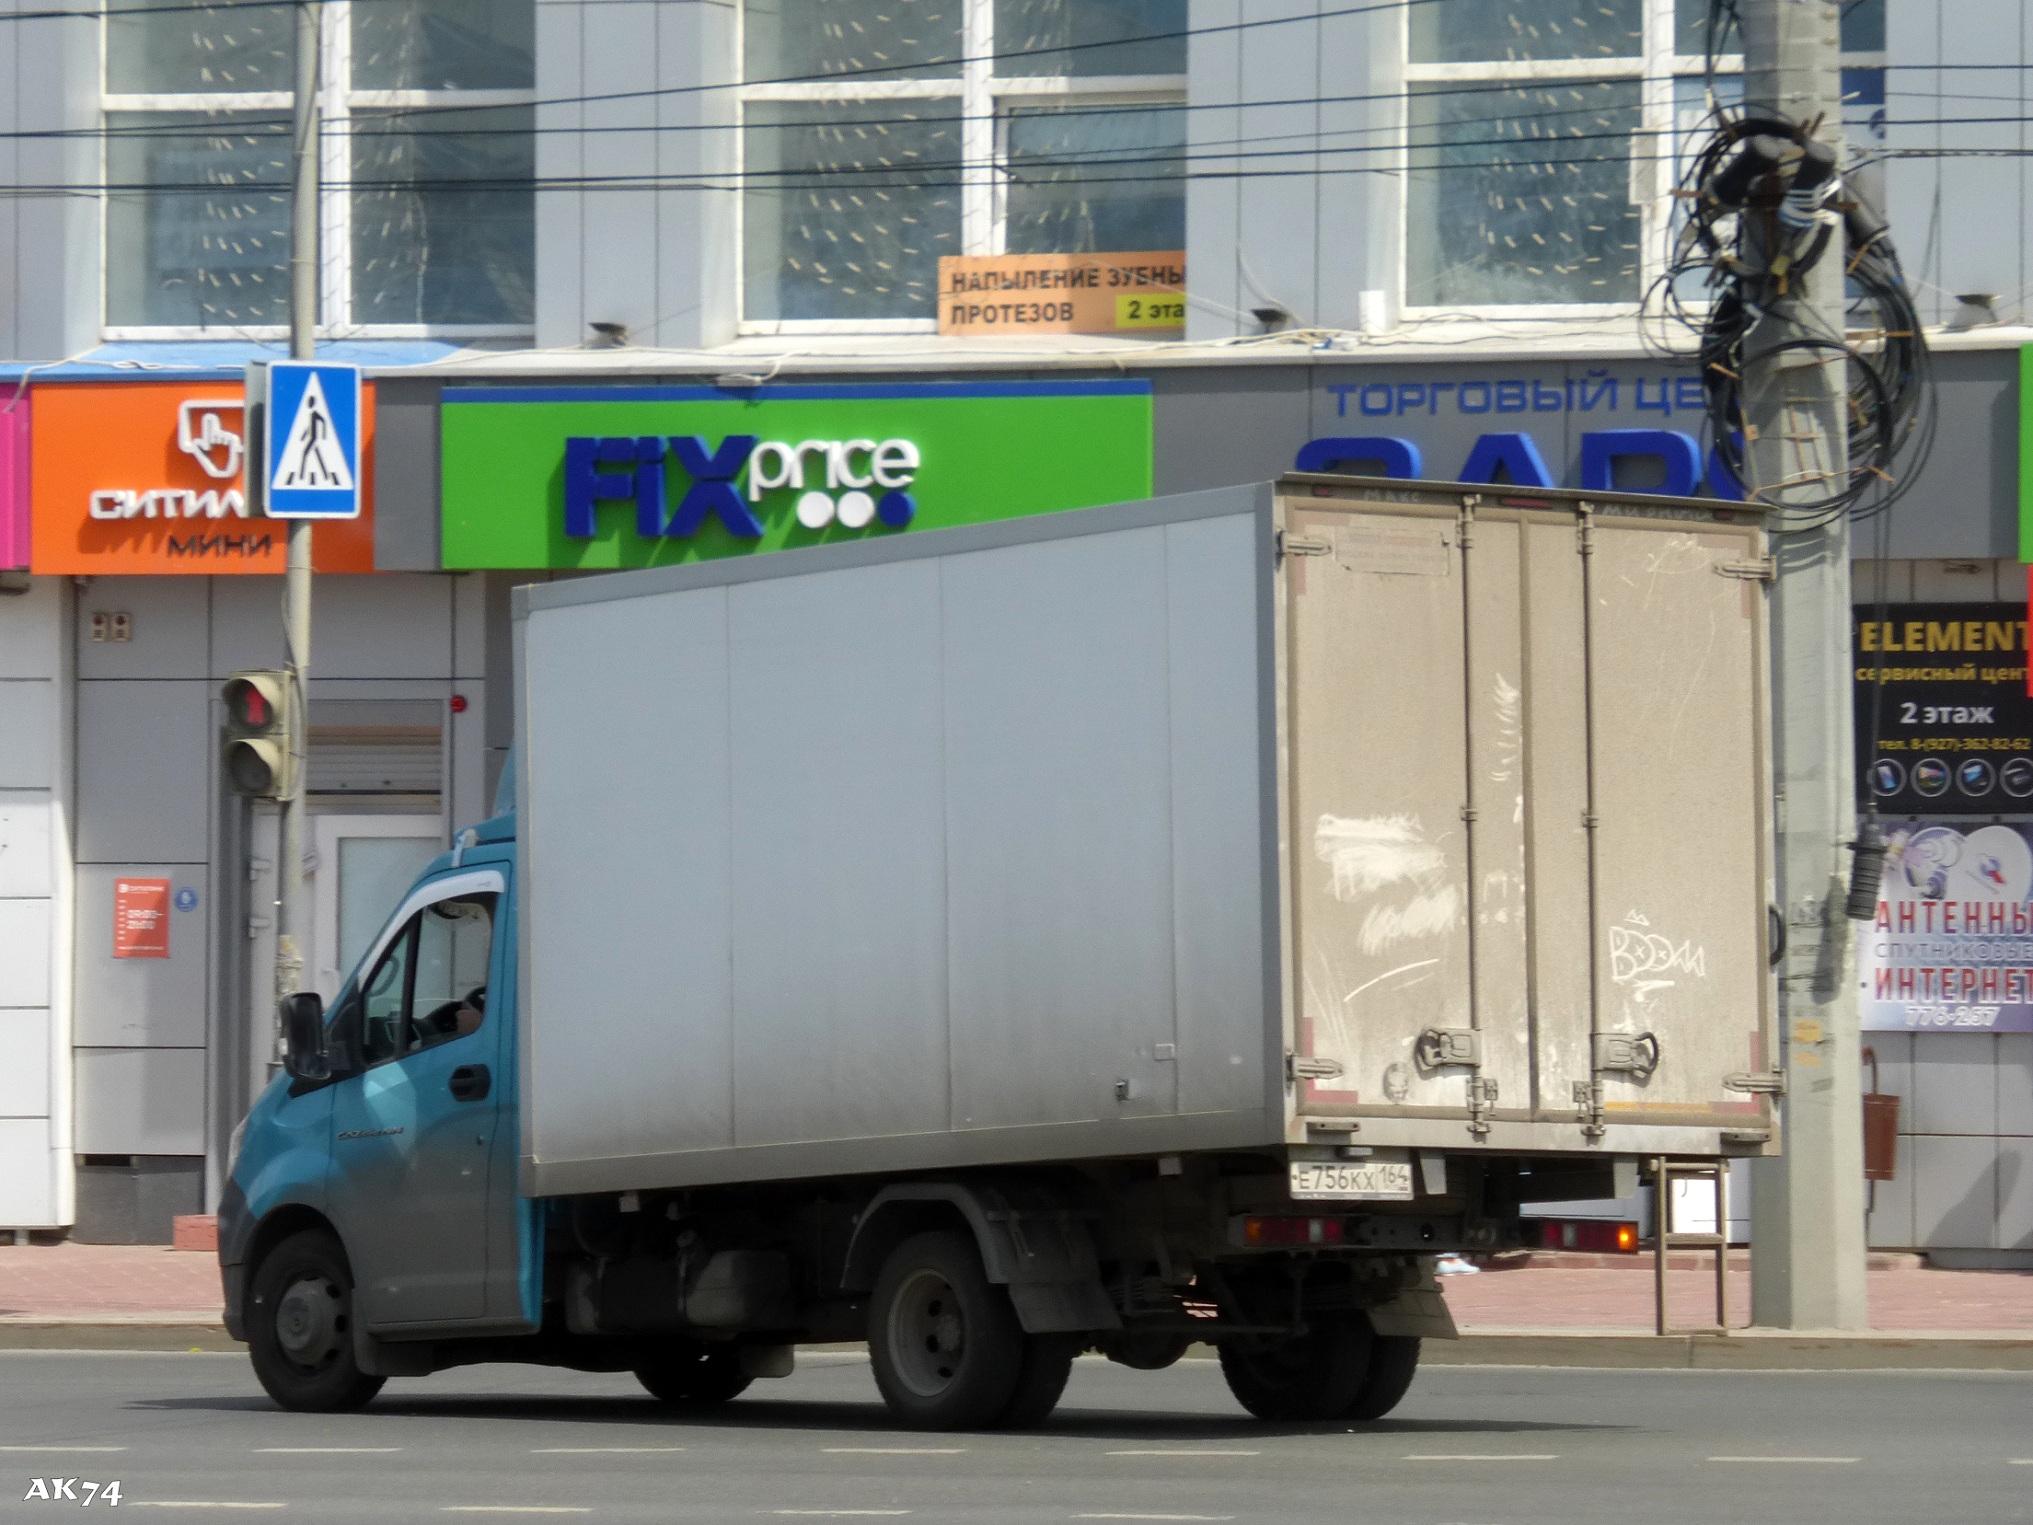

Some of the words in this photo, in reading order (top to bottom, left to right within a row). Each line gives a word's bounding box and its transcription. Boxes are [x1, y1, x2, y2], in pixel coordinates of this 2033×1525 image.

[952, 268, 1099, 293] НАПЫЛЕНИЕ
[952, 302, 1074, 325] ПРОТЕЗОВ
[1128, 300, 1141, 320] 2
[1327, 369, 1618, 417] ТОРГОВЫЙ
[748, 438, 921, 501] price
[167, 533, 271, 558] МИНИ
[1856, 662, 1977, 686] сервисный
[1900, 702, 1918, 724] 2
[1923, 705, 1995, 724] этаж
[1875, 901, 2033, 934] АНТЕННЫ
[1875, 967, 2033, 1001] ИНТЕРНЕТ
